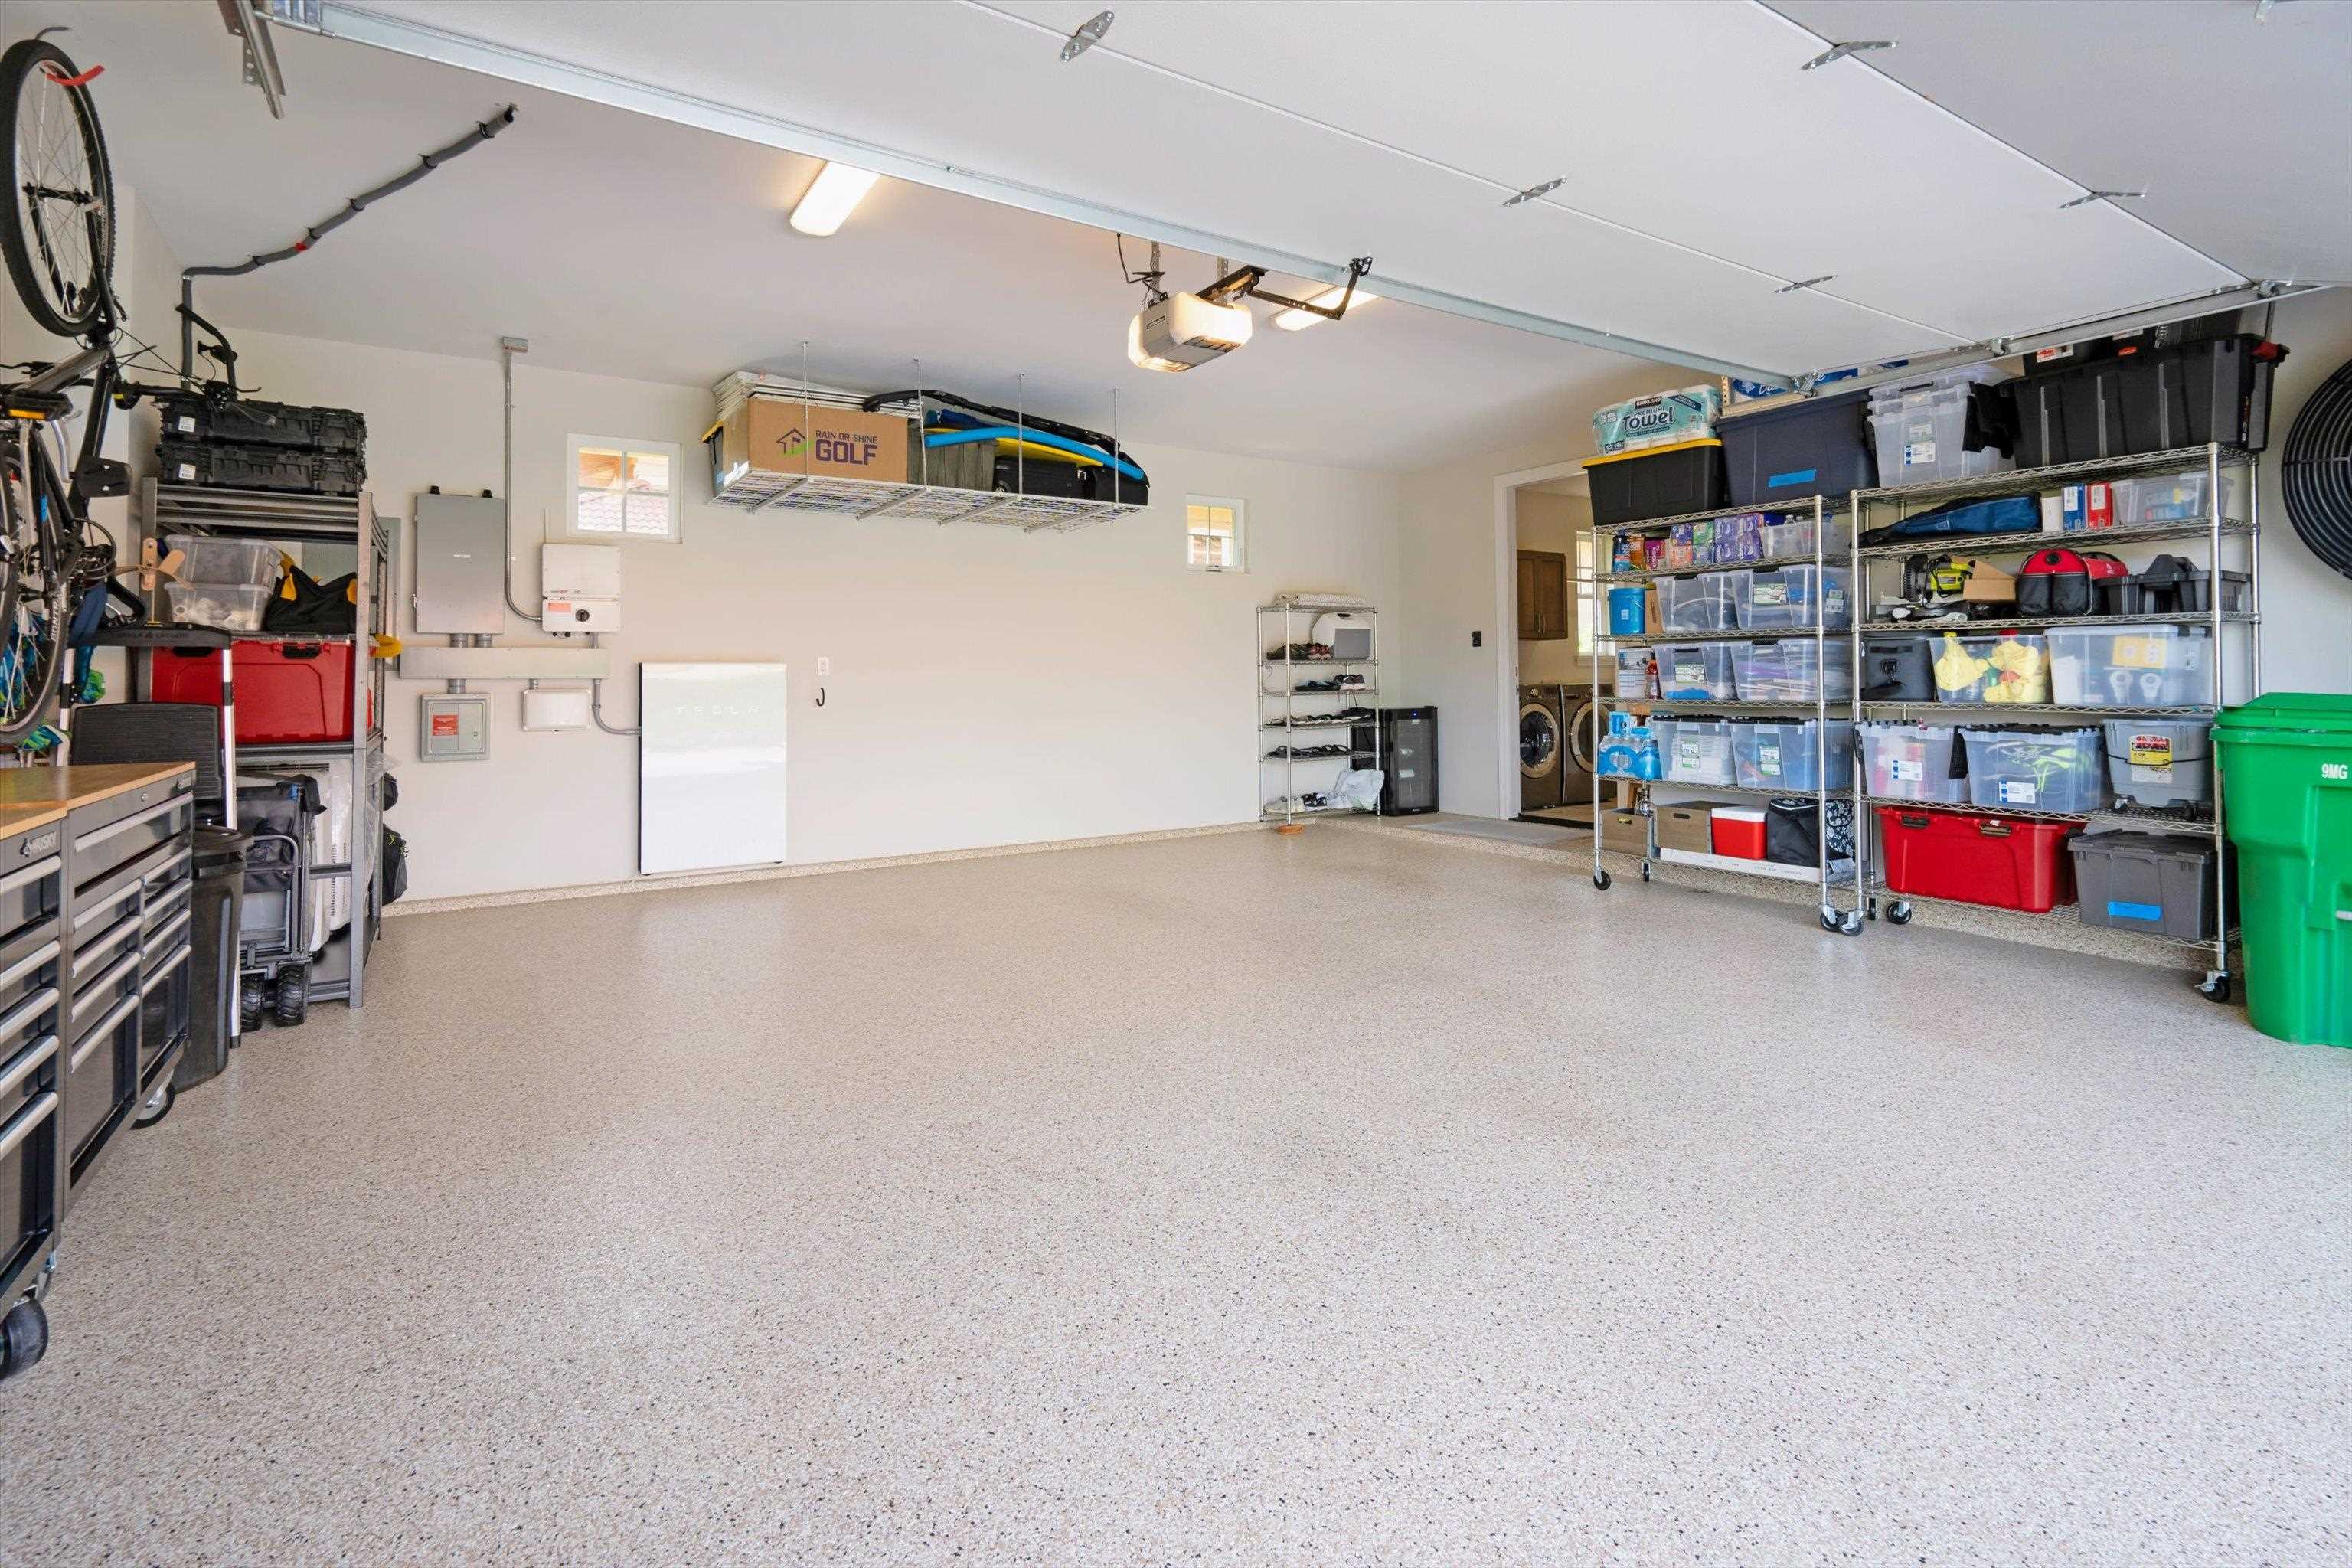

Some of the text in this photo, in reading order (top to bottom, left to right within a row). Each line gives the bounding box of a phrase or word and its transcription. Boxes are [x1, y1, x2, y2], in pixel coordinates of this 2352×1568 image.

[1634, 406, 1664, 416] PREMIUM
[1622, 406, 1674, 431] Towel
[815, 430, 877, 444] RAIN OR SHINE
[815, 439, 878, 466] GOLF
[674, 704, 760, 717] TESLA
